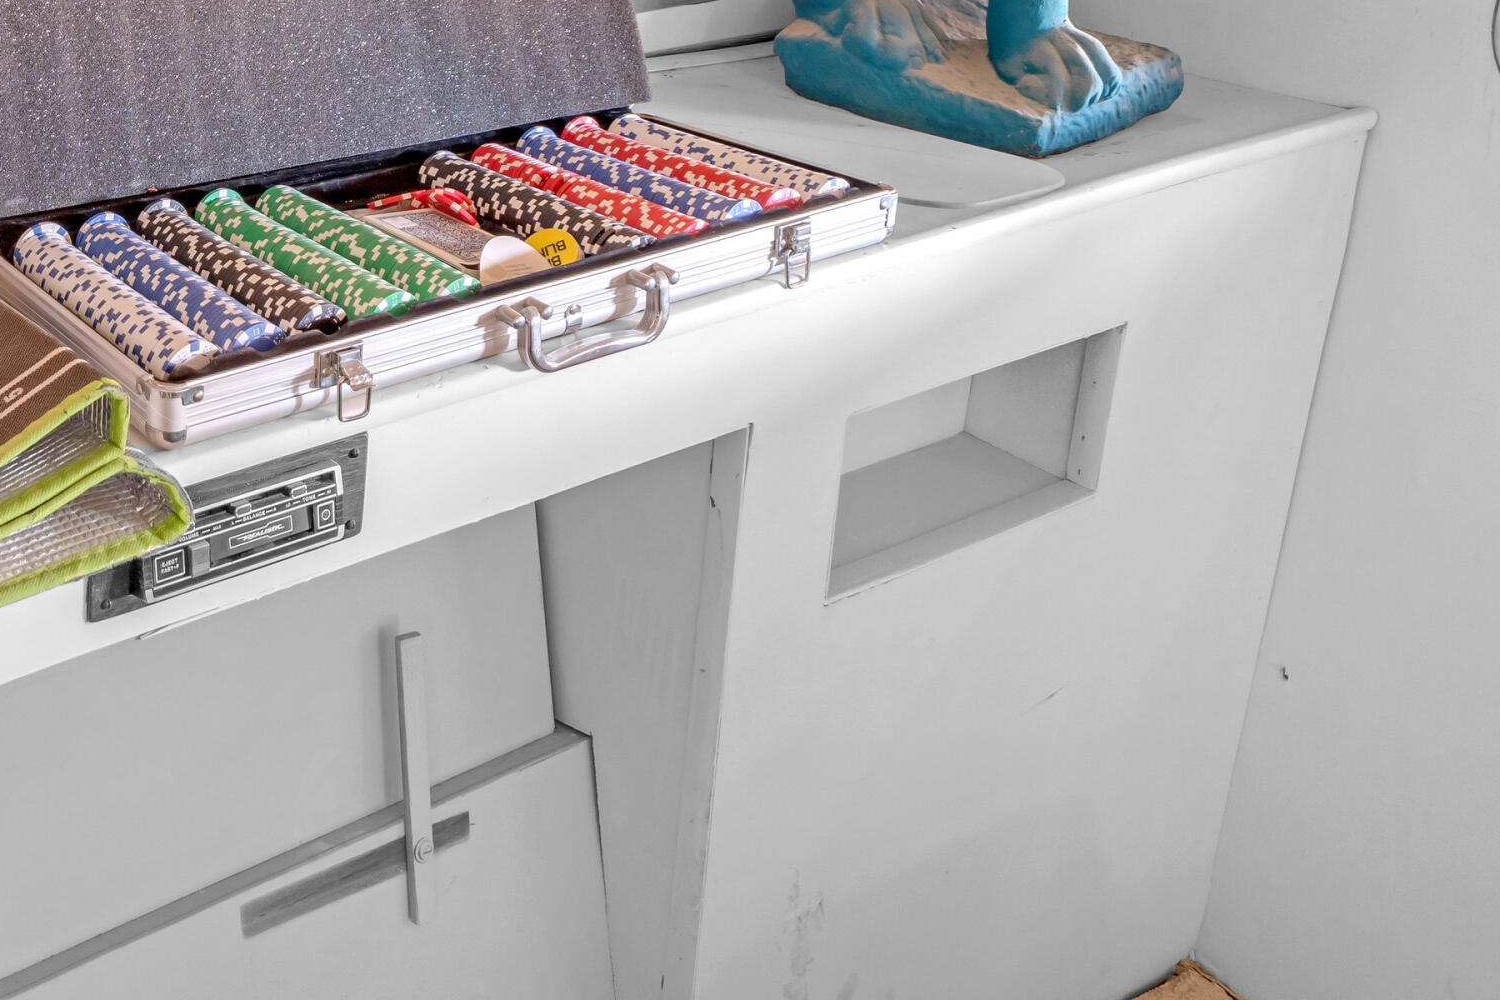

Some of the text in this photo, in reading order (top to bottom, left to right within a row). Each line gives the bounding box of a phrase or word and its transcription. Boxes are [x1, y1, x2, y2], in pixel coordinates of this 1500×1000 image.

[541, 240, 567, 257] BLI
[547, 255, 562, 267] BI
[3, 387, 24, 403] 5
[302, 495, 316, 503] TONE
[242, 510, 266, 522] BALANCE
[179, 531, 200, 543] VOLUME
[237, 523, 284, 541] REALISTIC
[161, 558, 179, 568] EJECT
